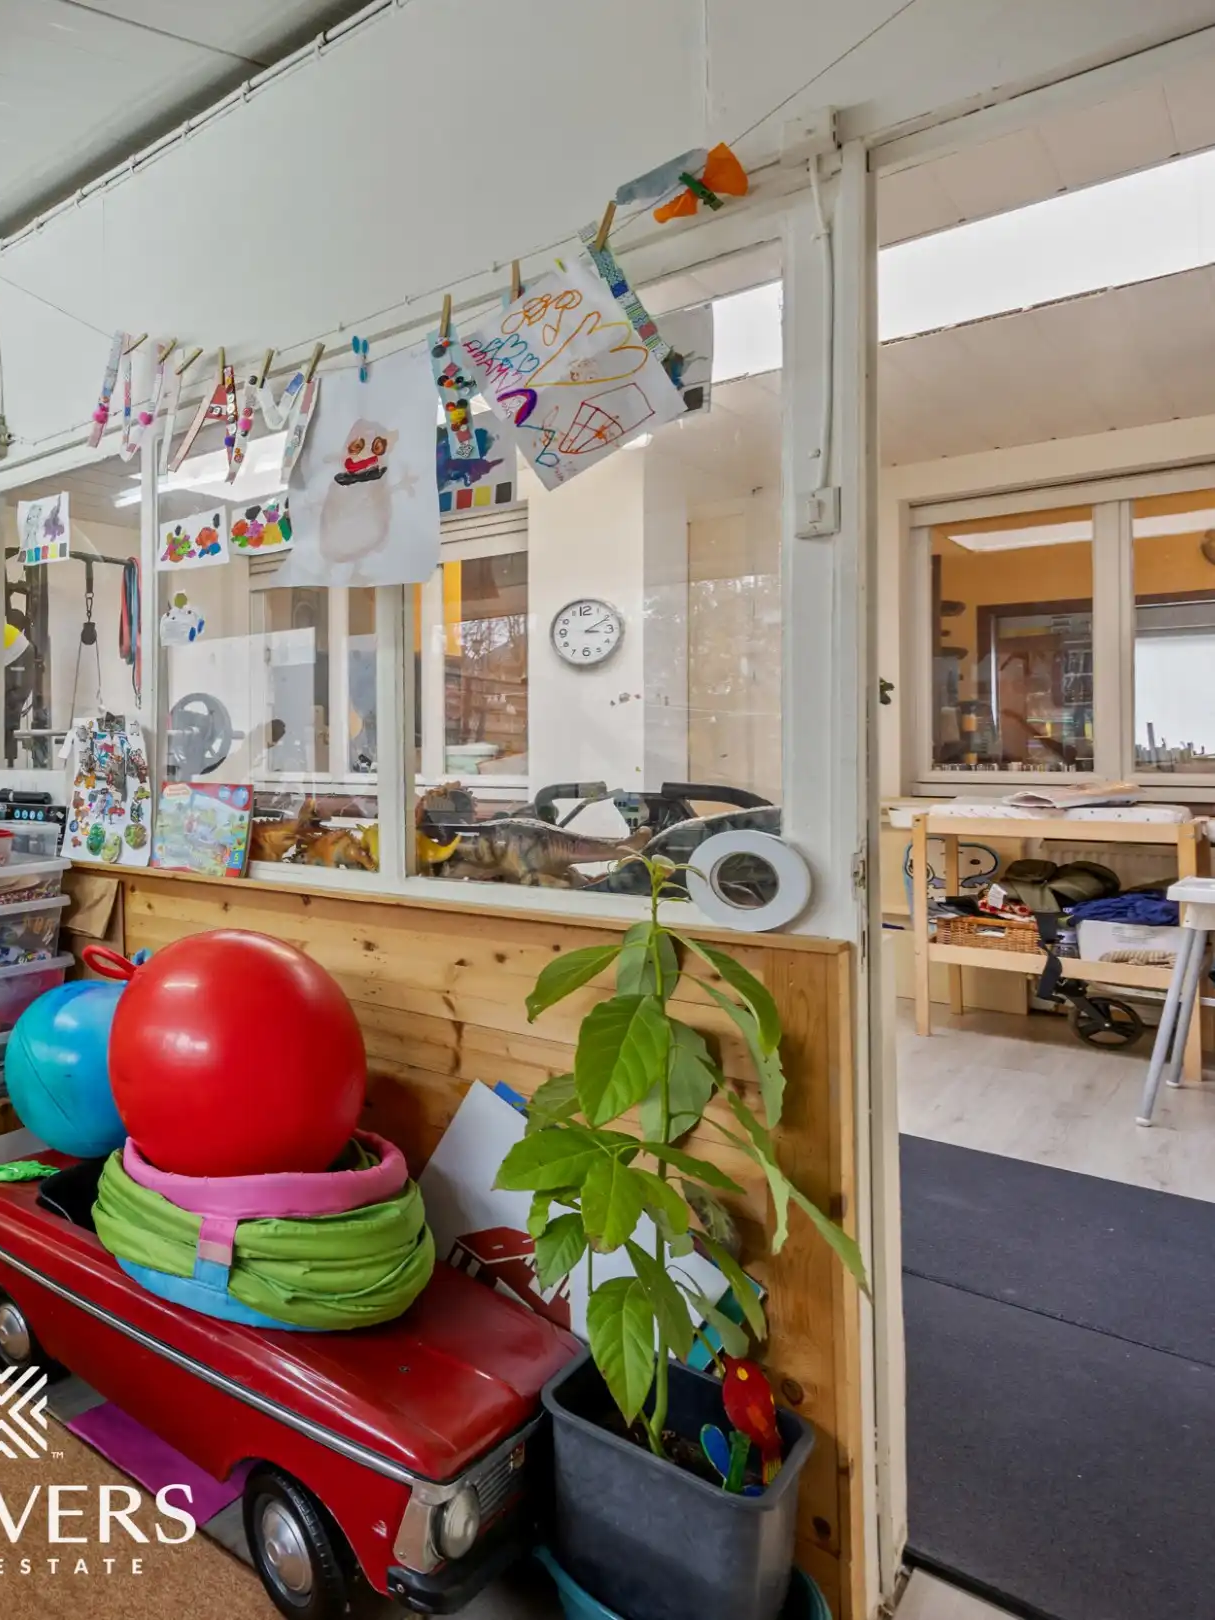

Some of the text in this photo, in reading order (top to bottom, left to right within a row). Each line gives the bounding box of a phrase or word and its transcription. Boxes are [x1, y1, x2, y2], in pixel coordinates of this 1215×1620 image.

[579, 605, 592, 616] 12
[559, 628, 567, 638] 9
[604, 624, 614, 634] 3
[582, 647, 591, 656] 6
